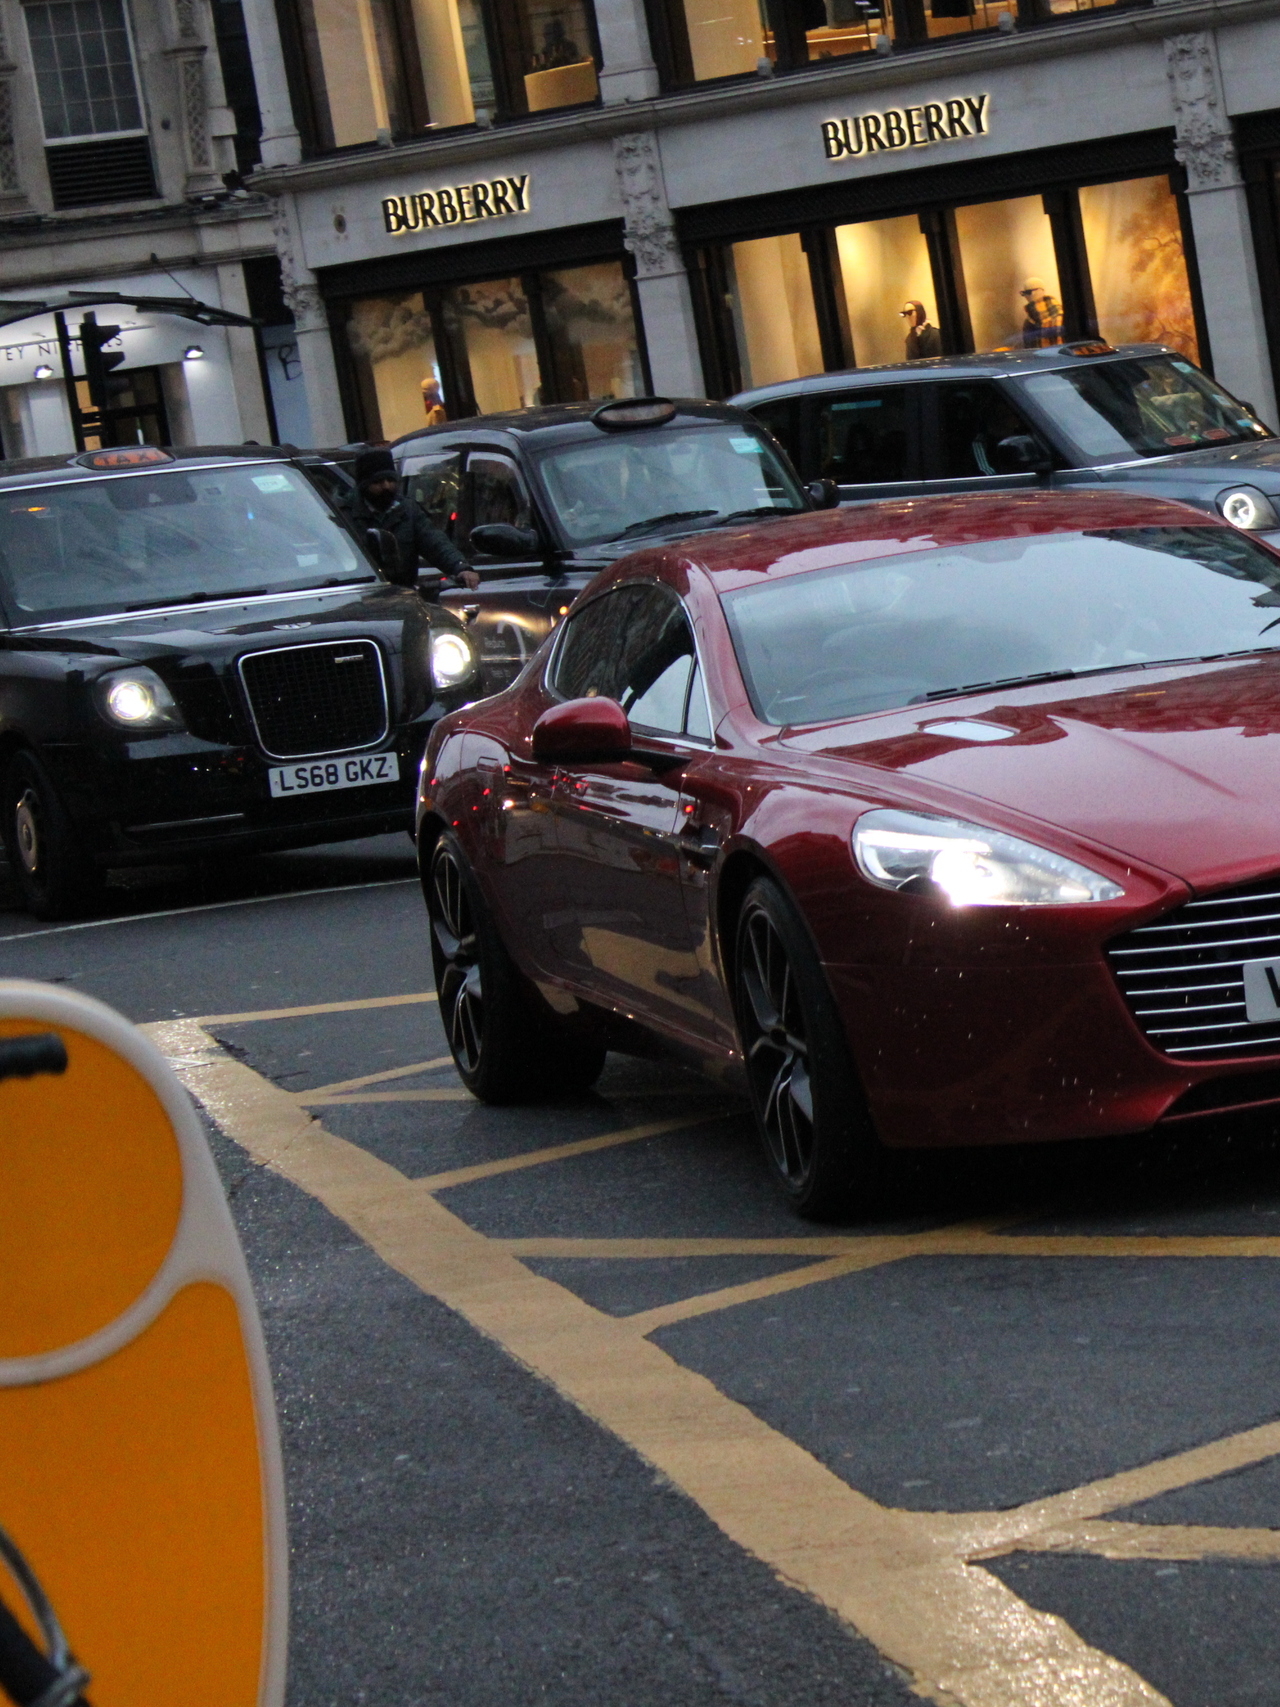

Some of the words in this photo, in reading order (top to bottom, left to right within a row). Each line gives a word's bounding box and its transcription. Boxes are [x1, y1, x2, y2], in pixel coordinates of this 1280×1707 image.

[821, 94, 988, 159] BURBERRY
[381, 174, 528, 233] BURBERRY
[280, 763, 339, 791] LS68
[345, 757, 389, 782] GKZ
